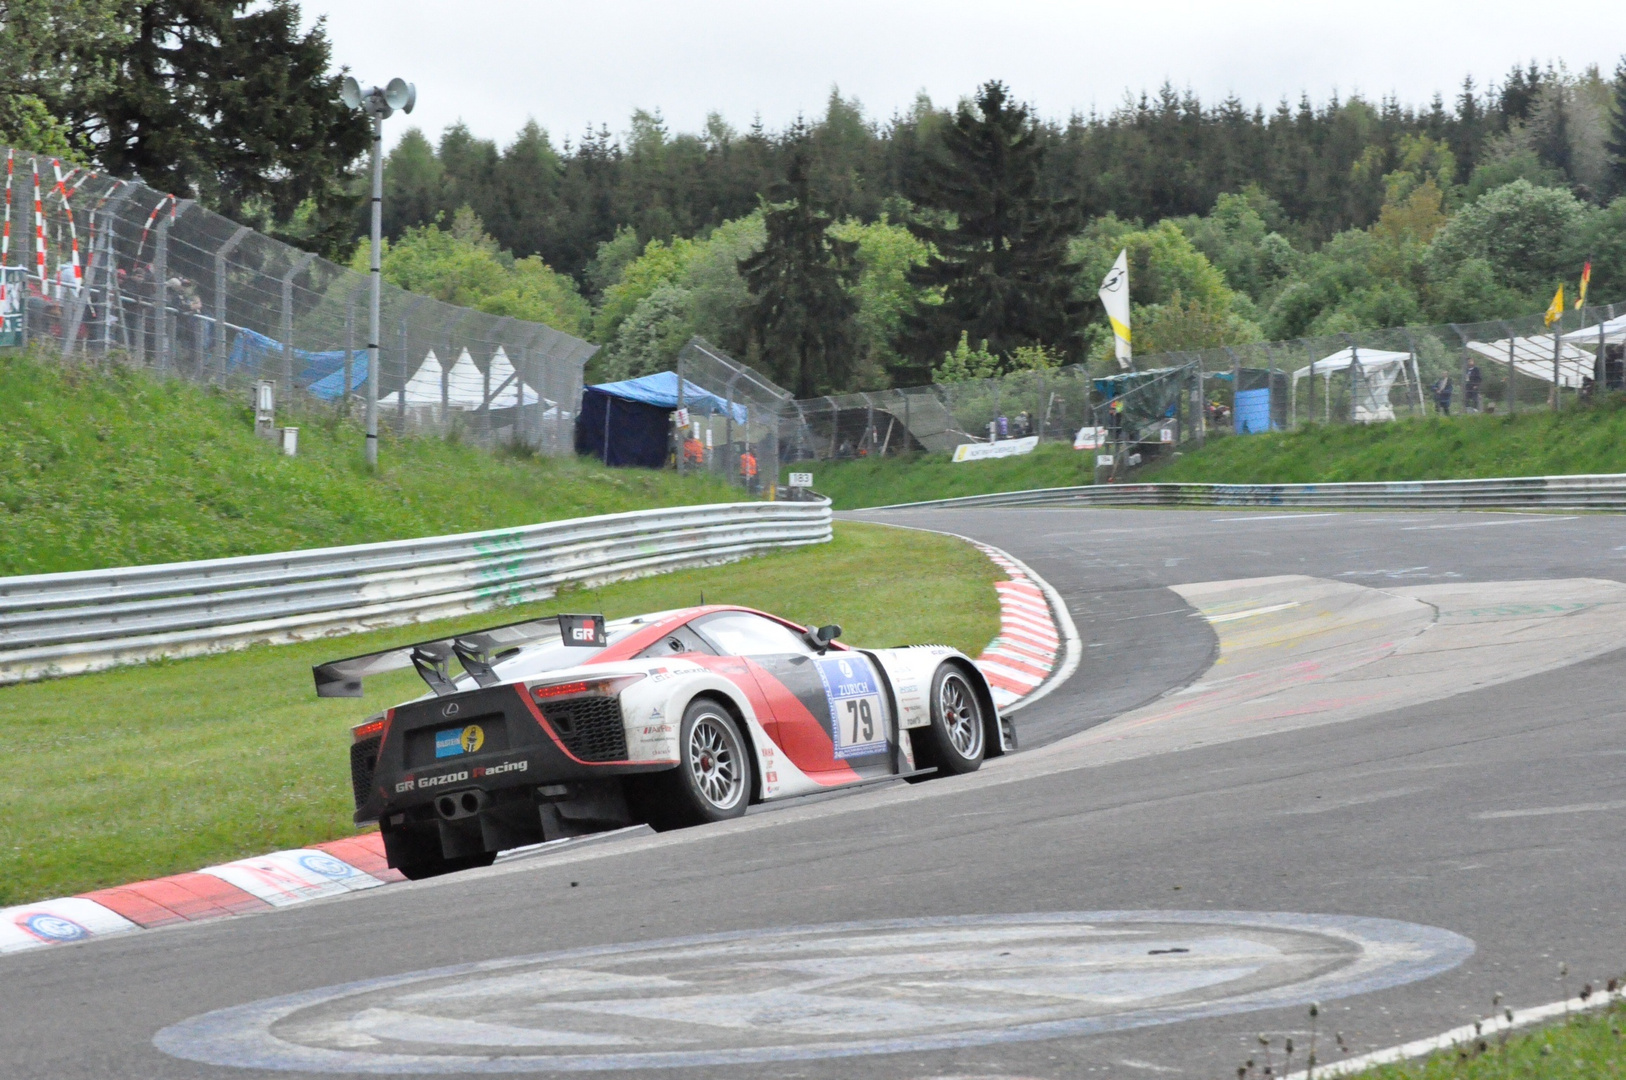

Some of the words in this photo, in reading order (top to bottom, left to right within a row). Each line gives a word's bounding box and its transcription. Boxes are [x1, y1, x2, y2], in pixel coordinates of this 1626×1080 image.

[794, 474, 810, 483] 183
[572, 628, 594, 641] GR
[839, 682, 869, 696] ZURICH
[846, 698, 874, 744] 79
[395, 780, 415, 793] GR
[472, 760, 528, 779] Racing
